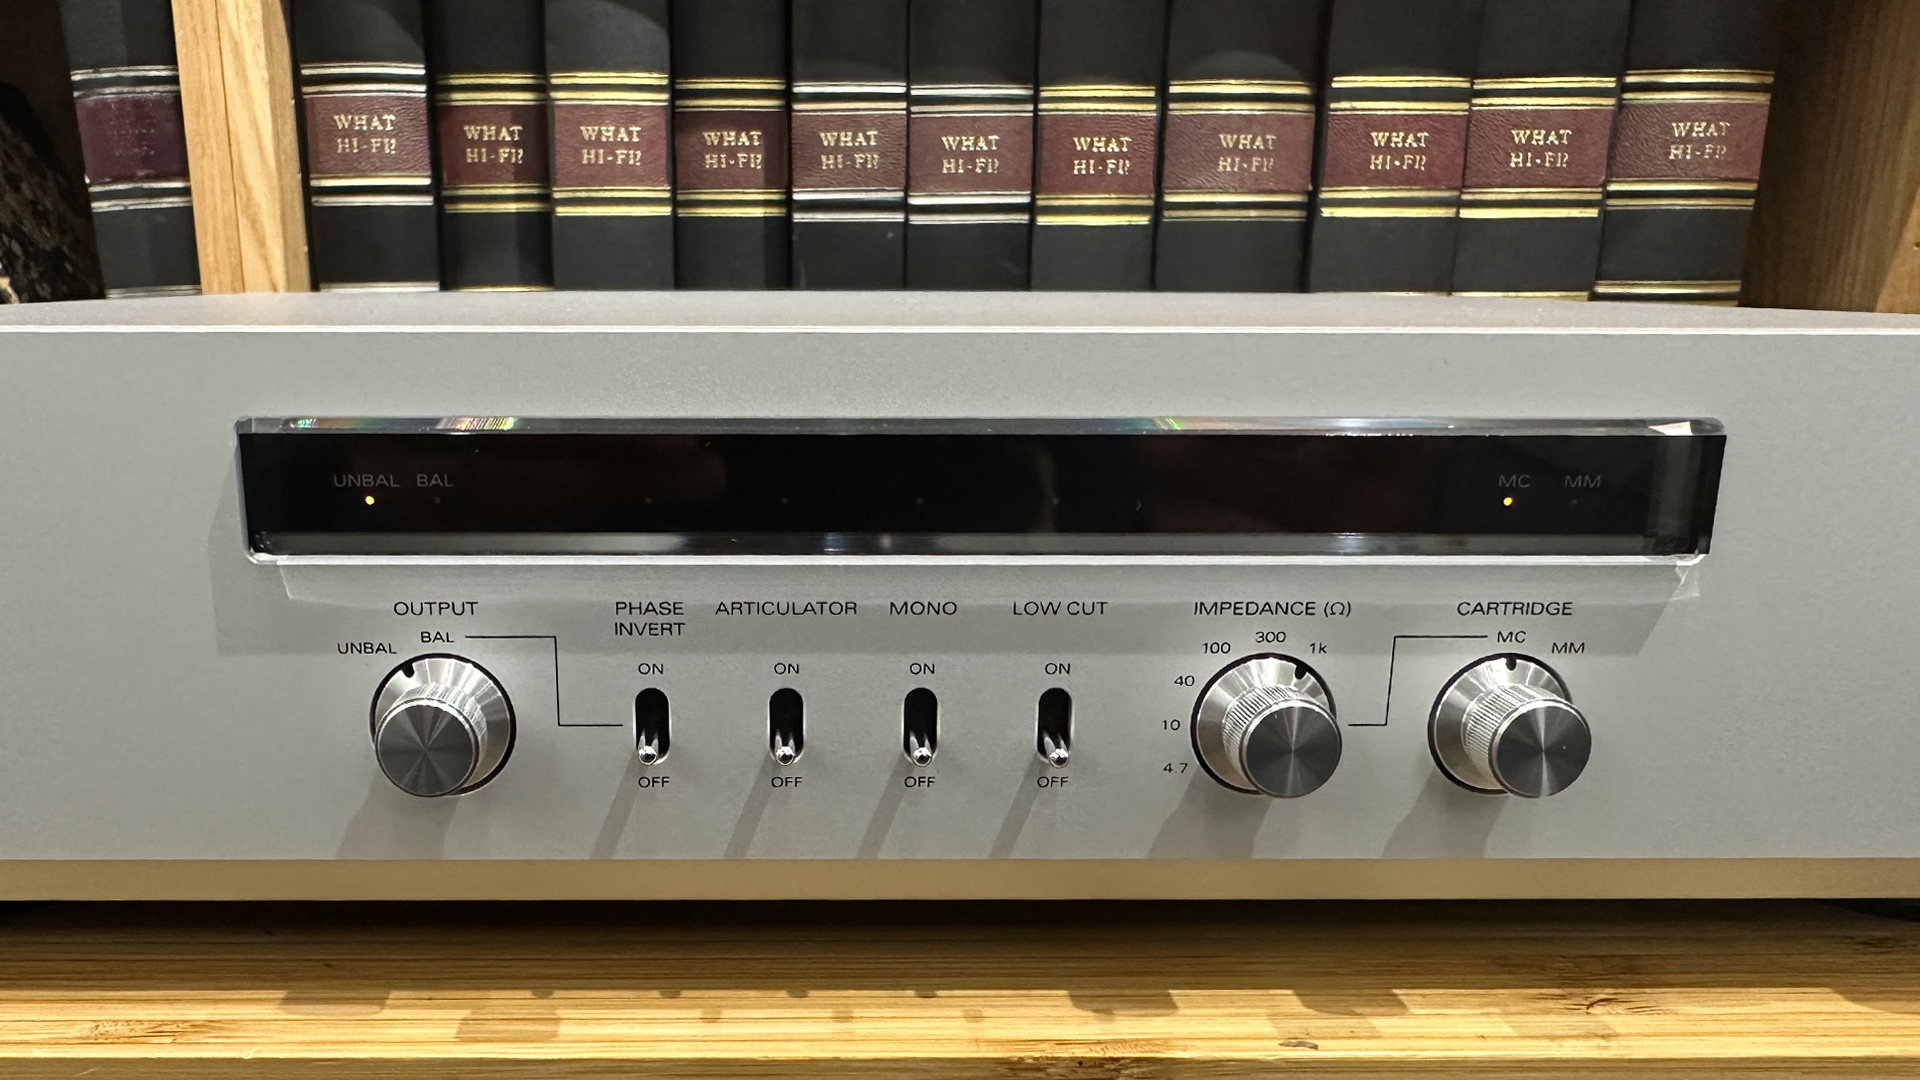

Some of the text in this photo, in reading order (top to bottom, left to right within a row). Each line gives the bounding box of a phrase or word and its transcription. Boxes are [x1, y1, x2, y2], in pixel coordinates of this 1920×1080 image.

[333, 113, 395, 131] WHAT
[1671, 121, 1731, 138] WHAT
[463, 124, 523, 142] WHAT
[579, 125, 642, 143] WHAT
[702, 130, 762, 147] WHAT
[819, 130, 879, 147] WHAT
[1370, 131, 1430, 148] WHAT
[1510, 129, 1573, 146] WHAT
[941, 134, 1000, 151] WHAT
[1072, 136, 1133, 153] WHAT
[1218, 133, 1277, 150] WHAT
[333, 473, 400, 488] UNBAL
[416, 473, 454, 488] BAL
[1498, 474, 1531, 489] MC
[1564, 474, 1602, 489] MM
[393, 601, 479, 617] OUTPUT
[615, 601, 684, 616] PHASE
[714, 601, 857, 616] ARTICULATOR
[889, 601, 958, 616] MONO
[1013, 601, 1109, 616] LOW CUT
[1193, 601, 1352, 618] IMPEDANCE (Ω)
[1456, 601, 1573, 617] CARTRIDGE
[614, 621, 686, 637] INVERT
[420, 630, 455, 644] BAL
[1255, 631, 1287, 644] 300
[1497, 630, 1527, 644] MC
[337, 641, 397, 655] UNBAL
[1202, 641, 1231, 655] 100
[1309, 642, 1328, 654] 1k
[1551, 641, 1586, 654] MM
[637, 662, 664, 676] ON
[773, 662, 800, 676] ON
[909, 662, 936, 676] ON
[1044, 662, 1071, 675] ON
[1173, 675, 1196, 687] 40
[1163, 718, 1181, 732] 10
[1163, 762, 1189, 774] 4.7
[637, 776, 670, 789] OFF
[770, 776, 803, 788] OFF
[903, 775, 936, 788] OFF
[1036, 775, 1069, 789] OFF
